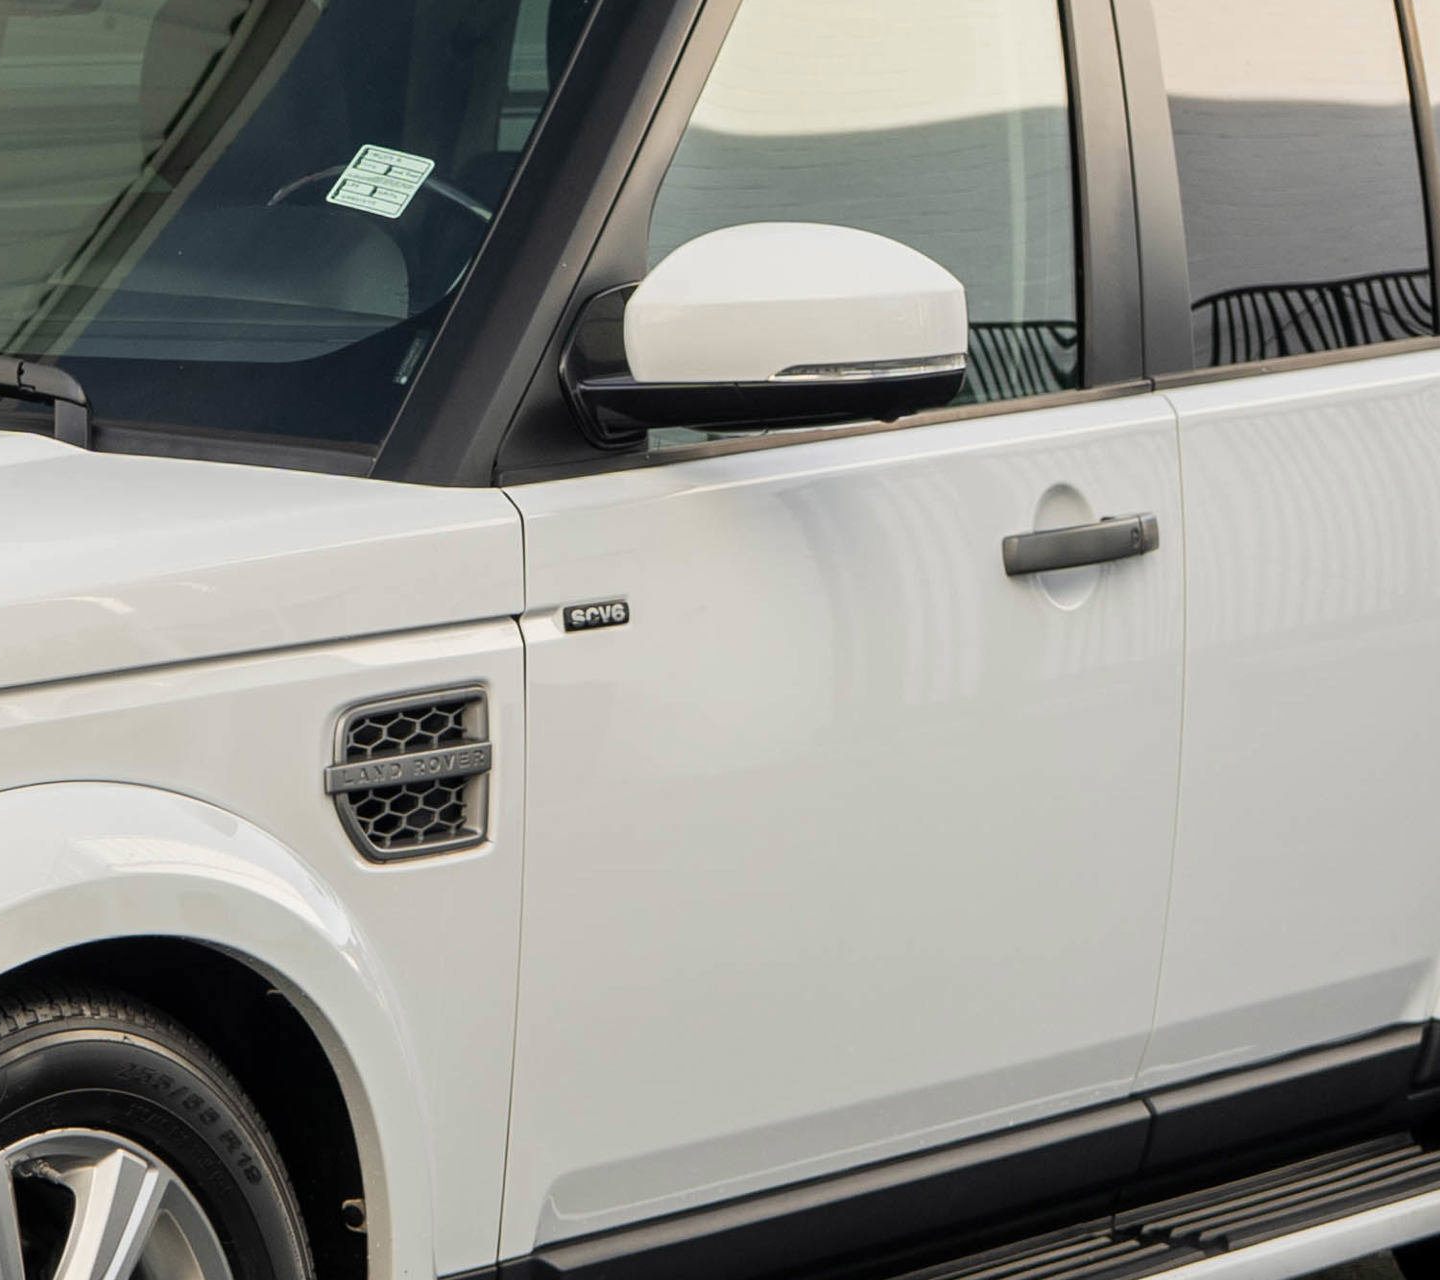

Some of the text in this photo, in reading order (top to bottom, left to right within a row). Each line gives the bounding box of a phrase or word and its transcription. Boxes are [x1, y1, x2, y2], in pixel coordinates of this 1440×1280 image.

[570, 603, 626, 627] SCV6
[340, 749, 487, 786] LAND ROVER
